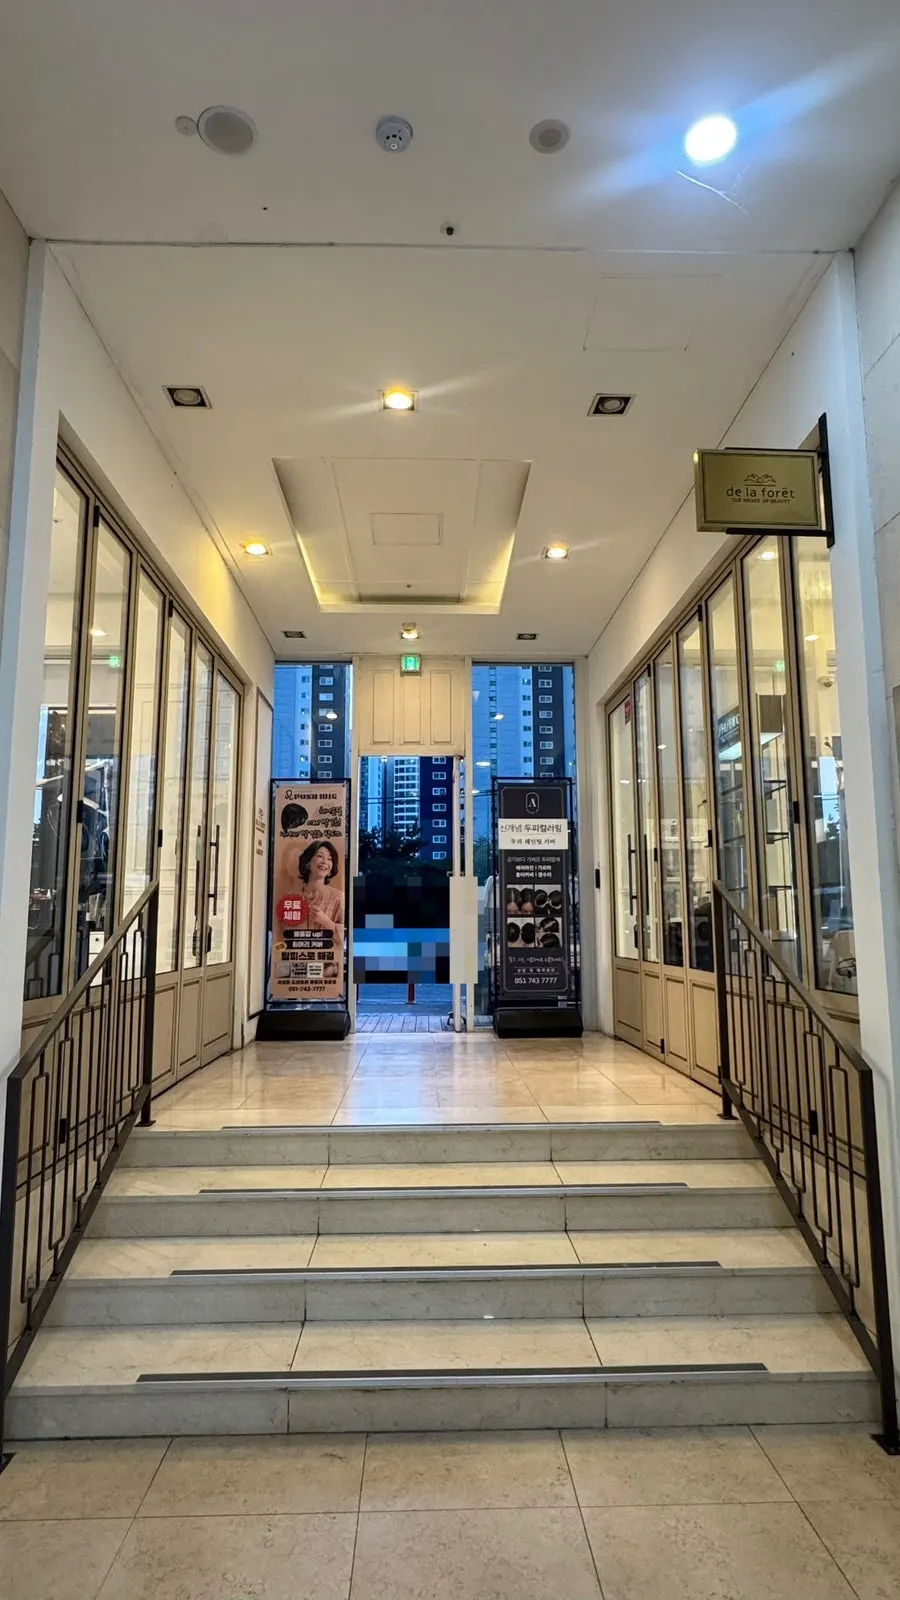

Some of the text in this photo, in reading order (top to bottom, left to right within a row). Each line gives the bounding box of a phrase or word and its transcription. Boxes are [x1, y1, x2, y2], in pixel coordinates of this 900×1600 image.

[726, 486, 742, 497] de
[745, 487, 757, 498] la
[500, 823, 562, 833] 신개념 두피컬러링
[283, 900, 302, 910] 무료
[283, 910, 302, 921] 체험
[312, 930, 324, 939] up!
[317, 951, 335, 961] 해결
